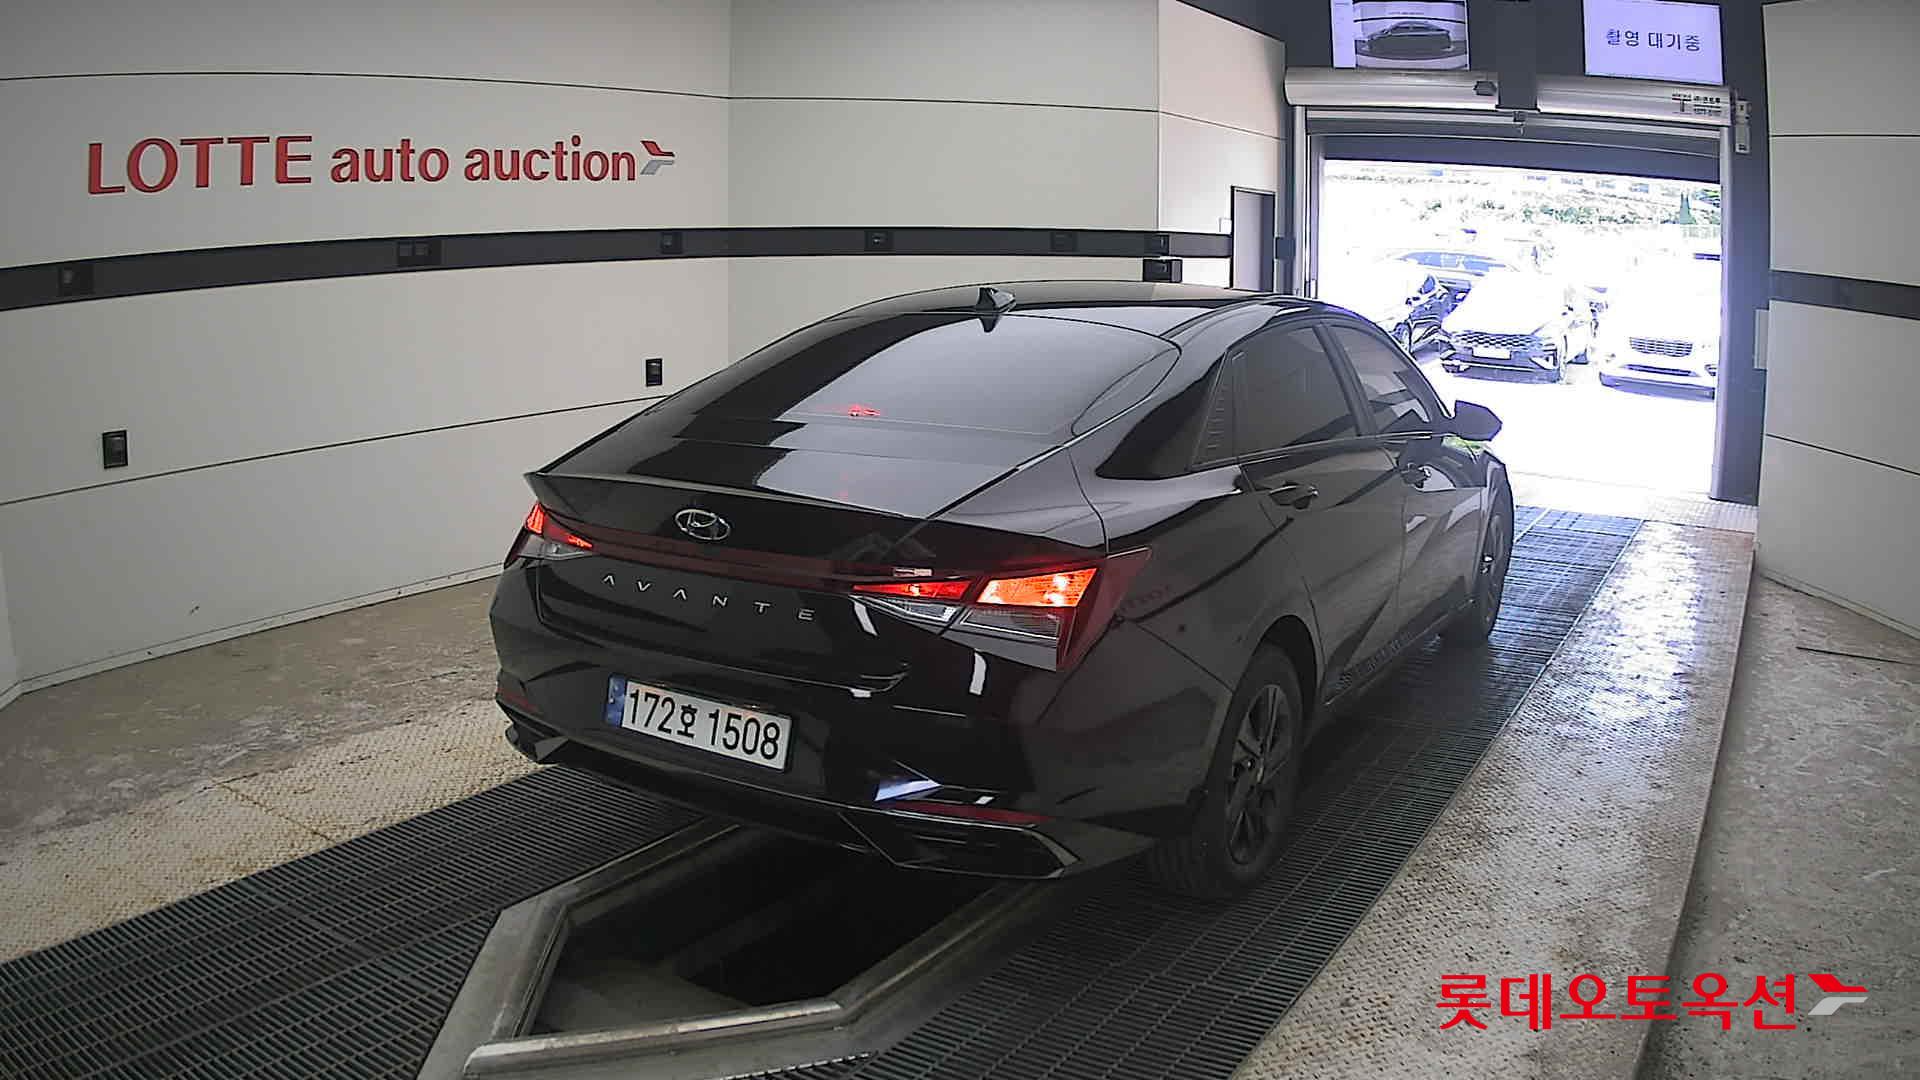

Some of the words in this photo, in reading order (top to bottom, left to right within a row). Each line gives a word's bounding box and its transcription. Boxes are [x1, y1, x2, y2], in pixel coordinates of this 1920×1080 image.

[1647, 32, 1701, 52] 대기중
[88, 136, 313, 194] LOTTE
[330, 138, 449, 182] auto
[464, 135, 636, 181] auction
[602, 574, 816, 622] AVANTE
[629, 688, 699, 739] 172호
[707, 708, 782, 761] 1508
